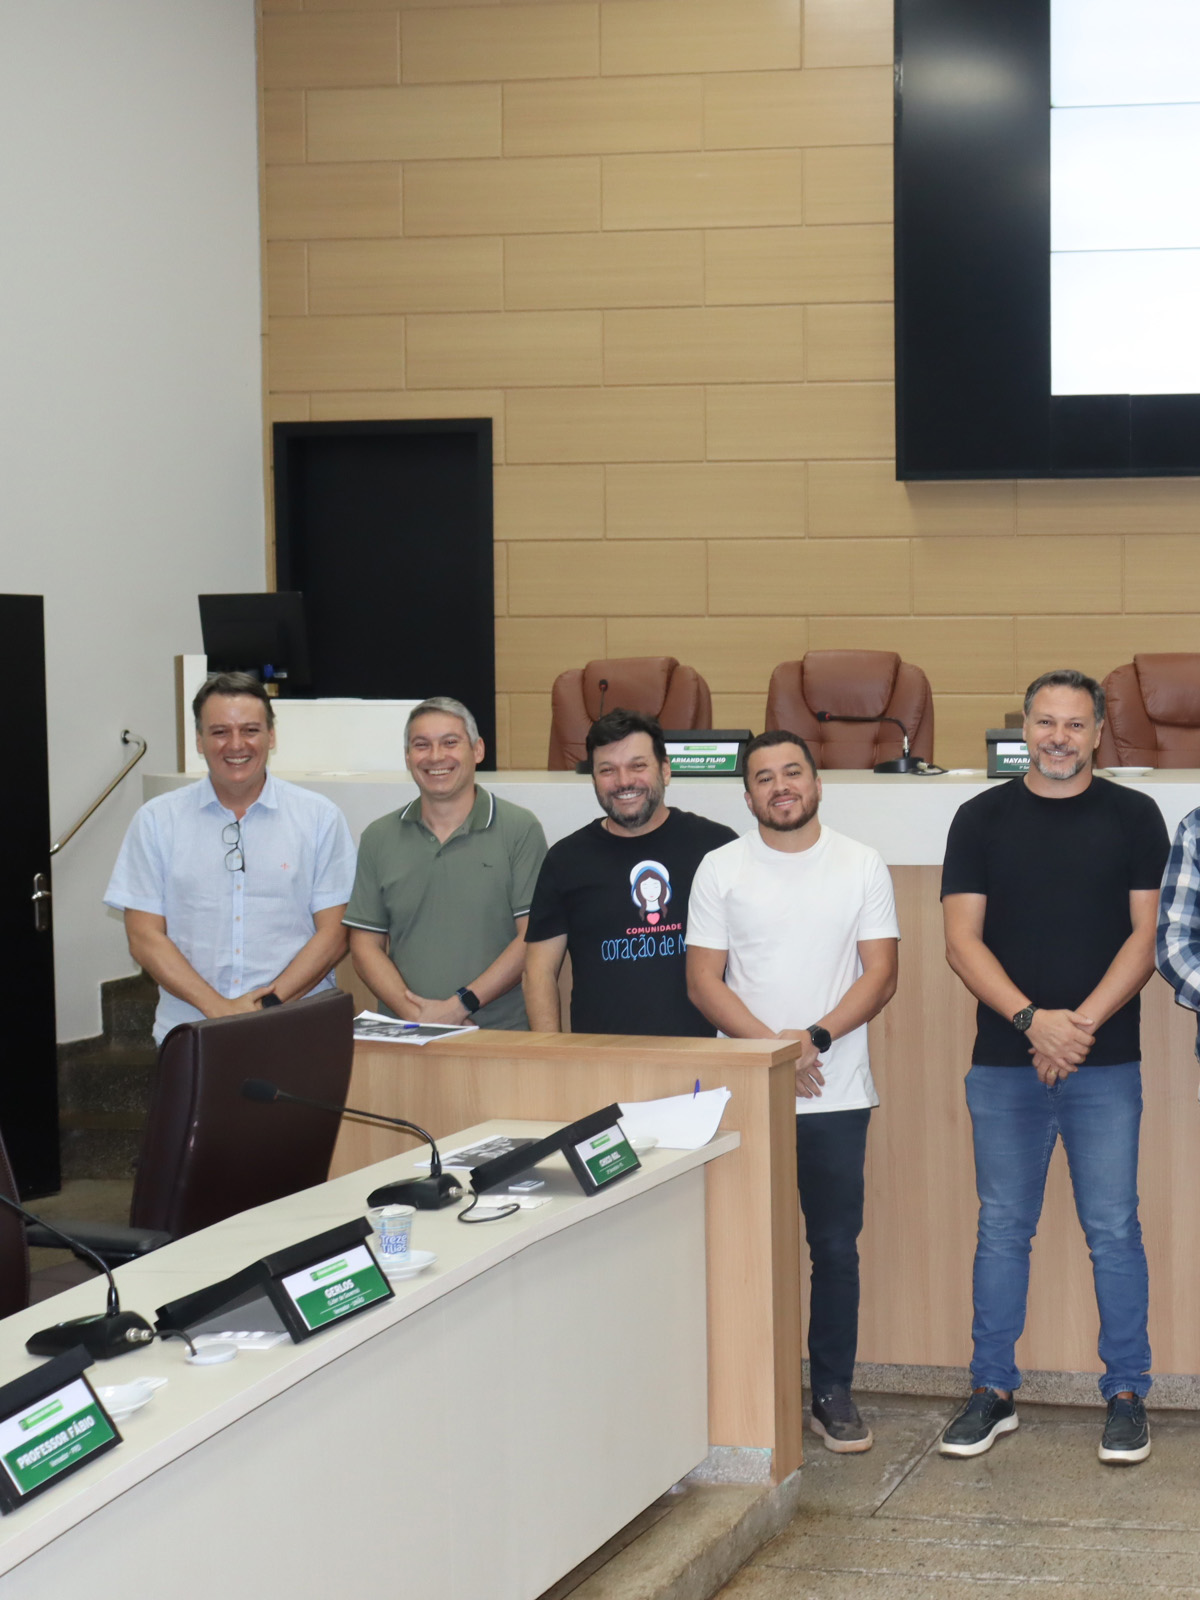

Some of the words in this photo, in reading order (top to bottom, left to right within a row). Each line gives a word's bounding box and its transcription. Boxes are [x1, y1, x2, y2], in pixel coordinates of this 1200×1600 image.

[626, 923, 683, 935] COMUNIDADE
[601, 934, 656, 961] coração
[659, 935, 675, 956] de
[324, 1278, 355, 1299] GERLOS
[16, 1430, 70, 1470] PROFESSOR
[66, 1415, 96, 1439] FÁBIO
